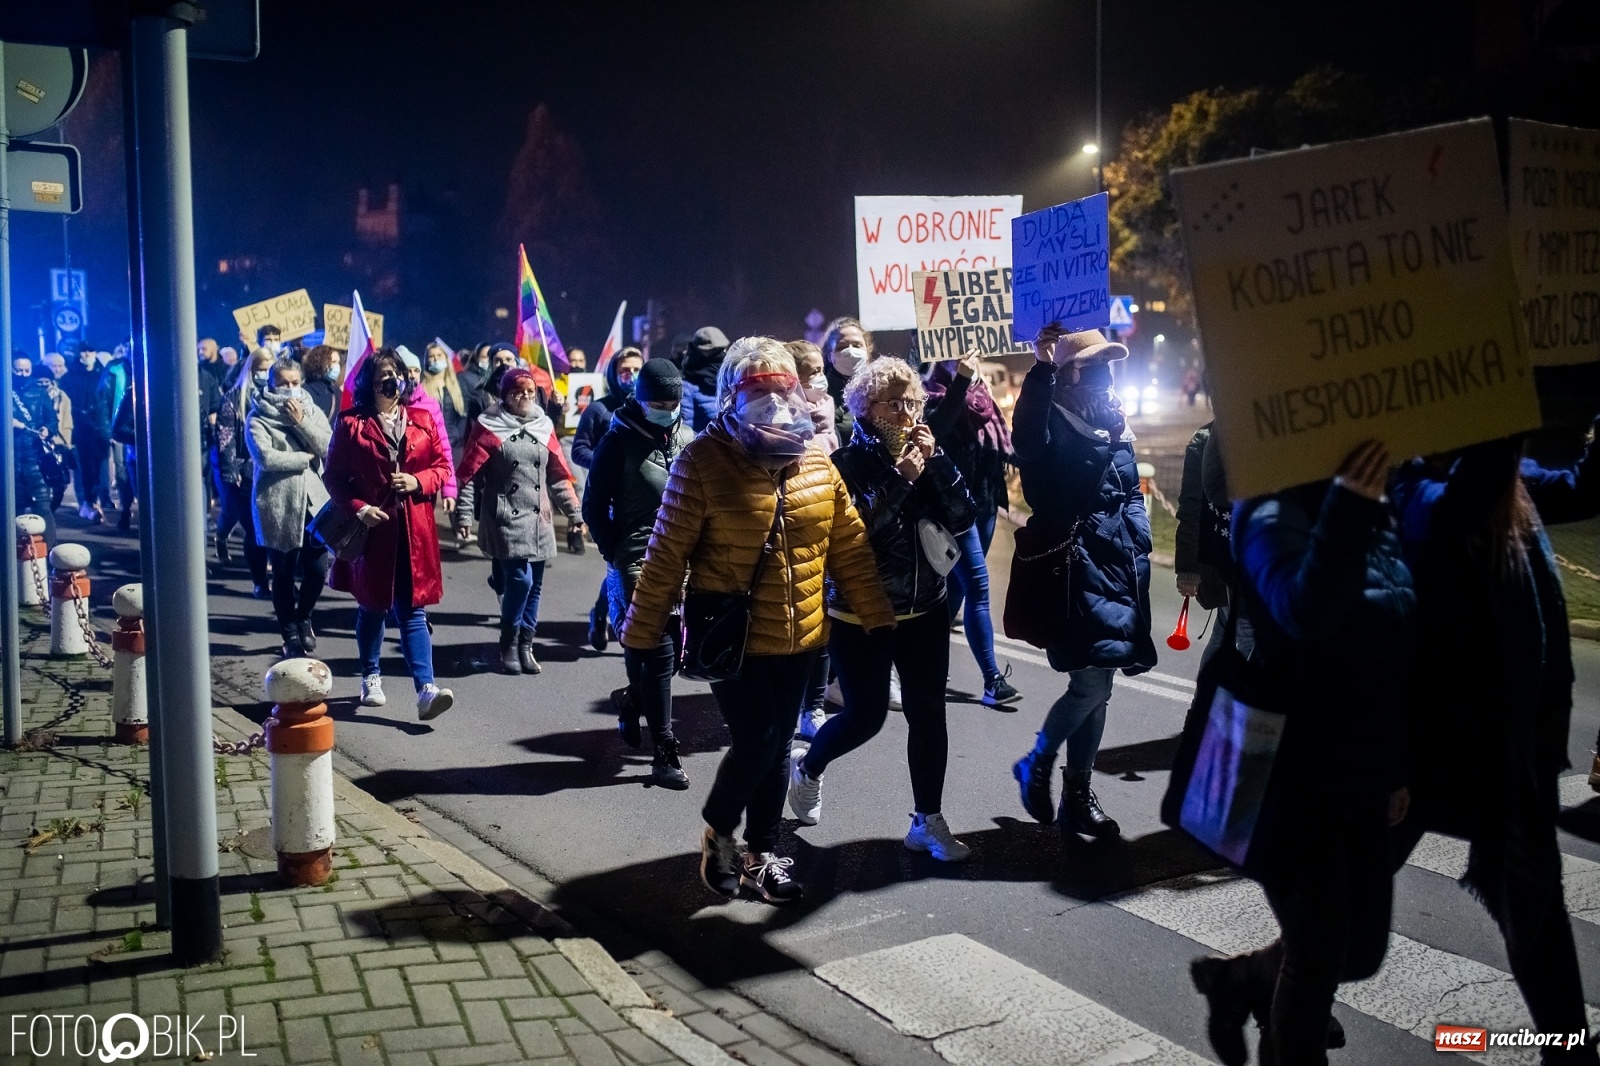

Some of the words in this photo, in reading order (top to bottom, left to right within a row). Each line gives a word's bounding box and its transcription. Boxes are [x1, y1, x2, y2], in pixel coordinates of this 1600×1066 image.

[1281, 176, 1395, 234] JAREK
[862, 217, 881, 243] W
[898, 208, 1003, 243] OBRONIE
[1023, 202, 1086, 247] DUDA
[1043, 259, 1059, 283] IN
[1064, 249, 1109, 280] VITRO
[1226, 241, 1372, 310] KOBIETA
[1378, 228, 1423, 276] TO
[1431, 217, 1484, 268] NIE
[242, 304, 271, 327] JEJ
[327, 309, 343, 323] GO
[1020, 290, 1041, 310] TO
[1042, 288, 1109, 324] PIZZERIA
[1306, 299, 1416, 360] JAJKO
